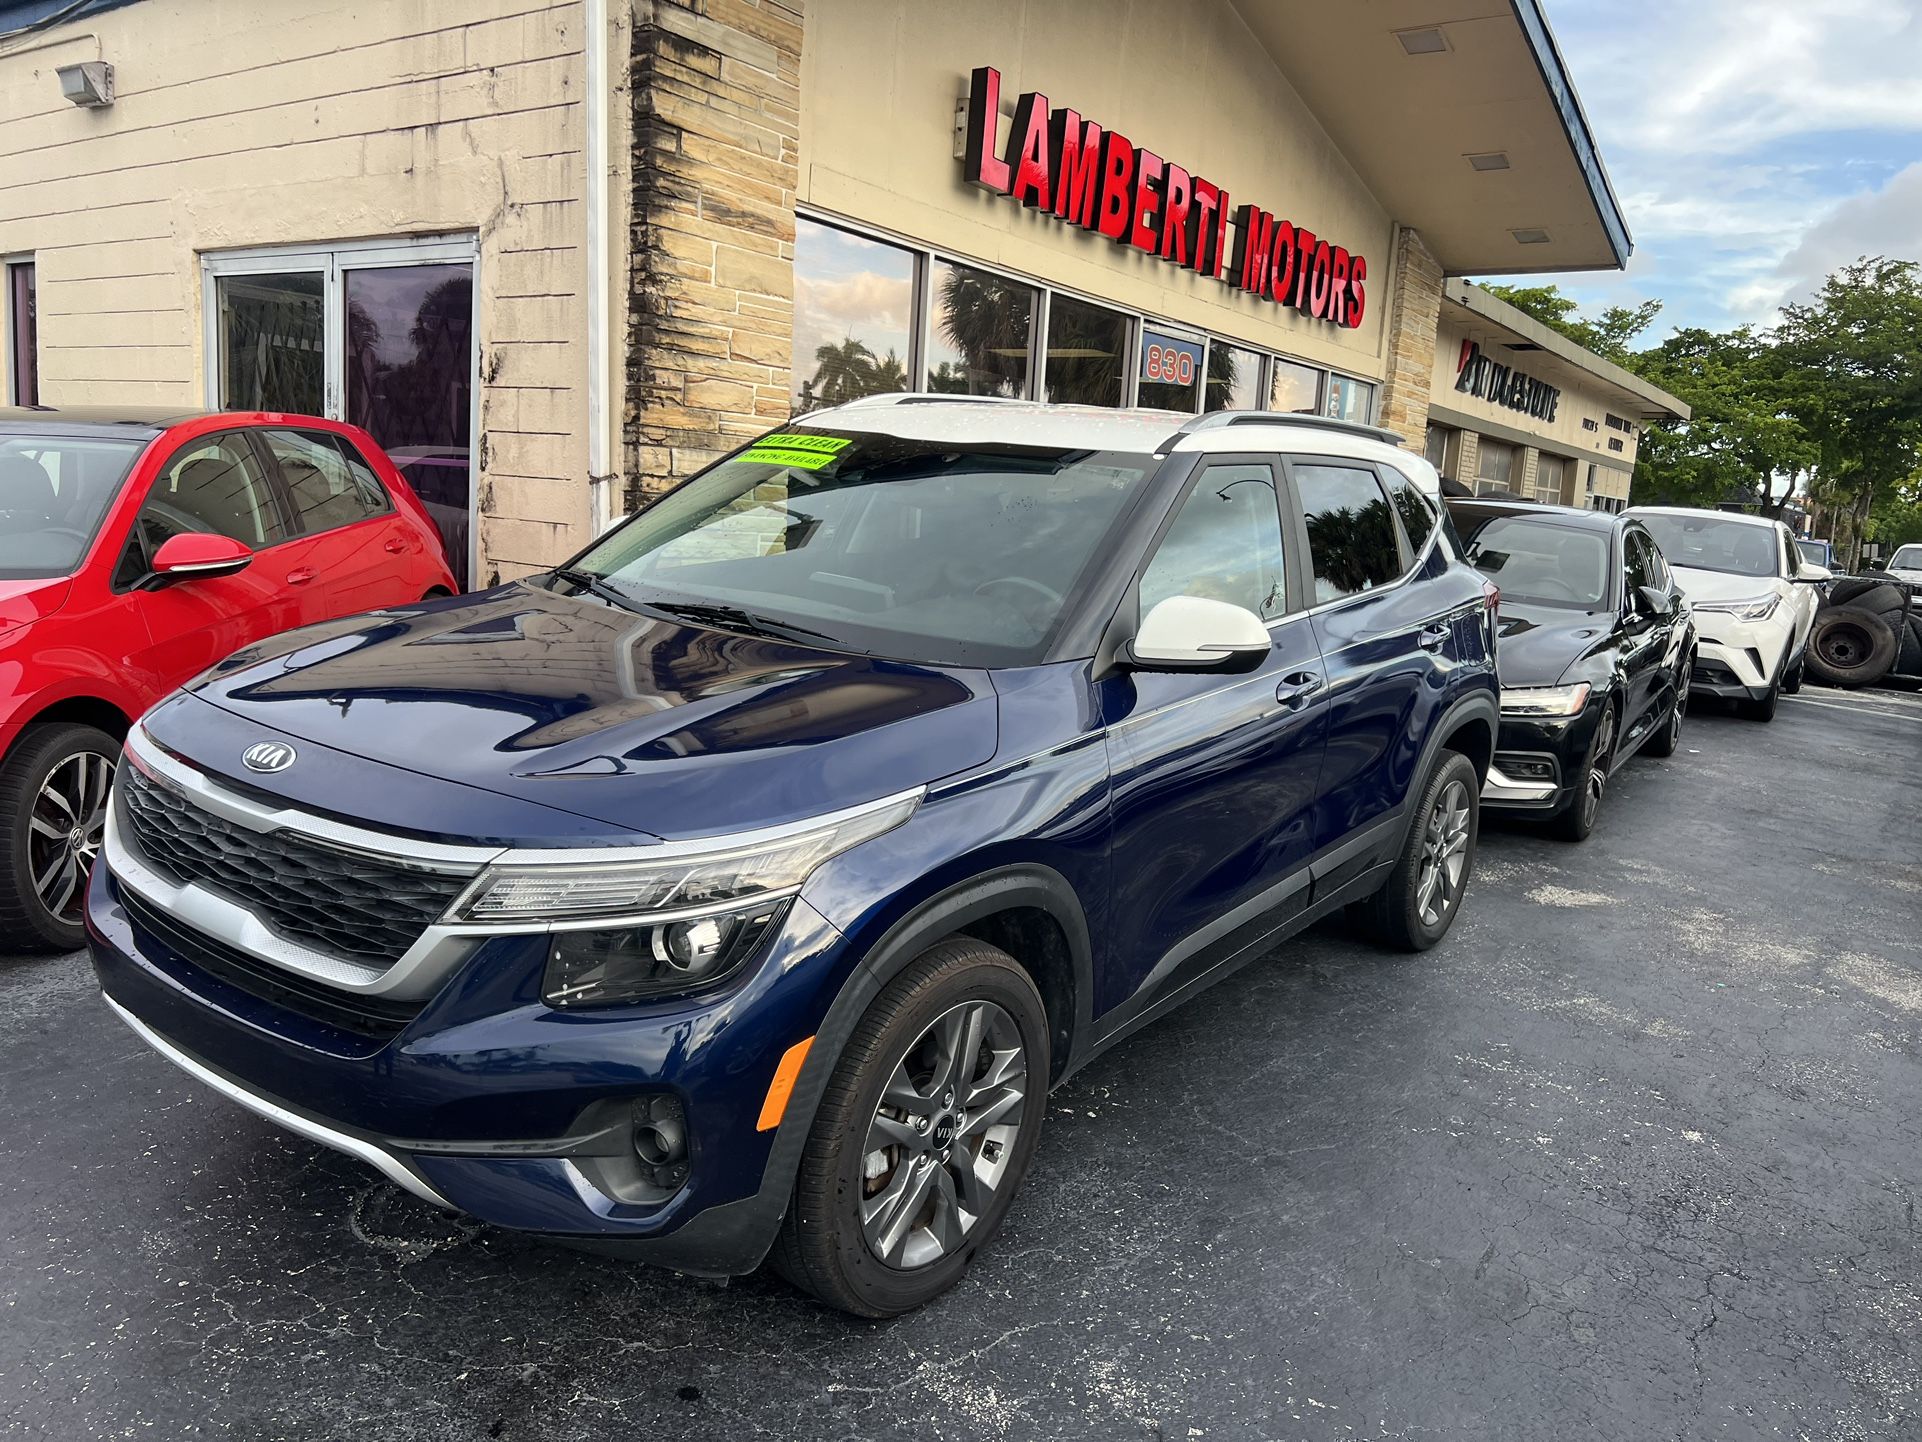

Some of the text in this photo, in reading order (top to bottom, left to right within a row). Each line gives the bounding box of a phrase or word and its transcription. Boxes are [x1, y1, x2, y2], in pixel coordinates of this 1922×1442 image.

[965, 66, 1366, 329] LAMBERTI MOTORS
[1146, 344, 1195, 386] 830
[1455, 338, 1560, 424] BRIDGESTONE
[762, 435, 845, 450] EXTRA CLEAN
[243, 742, 290, 770] KIA
[937, 1126, 954, 1139] KIA
